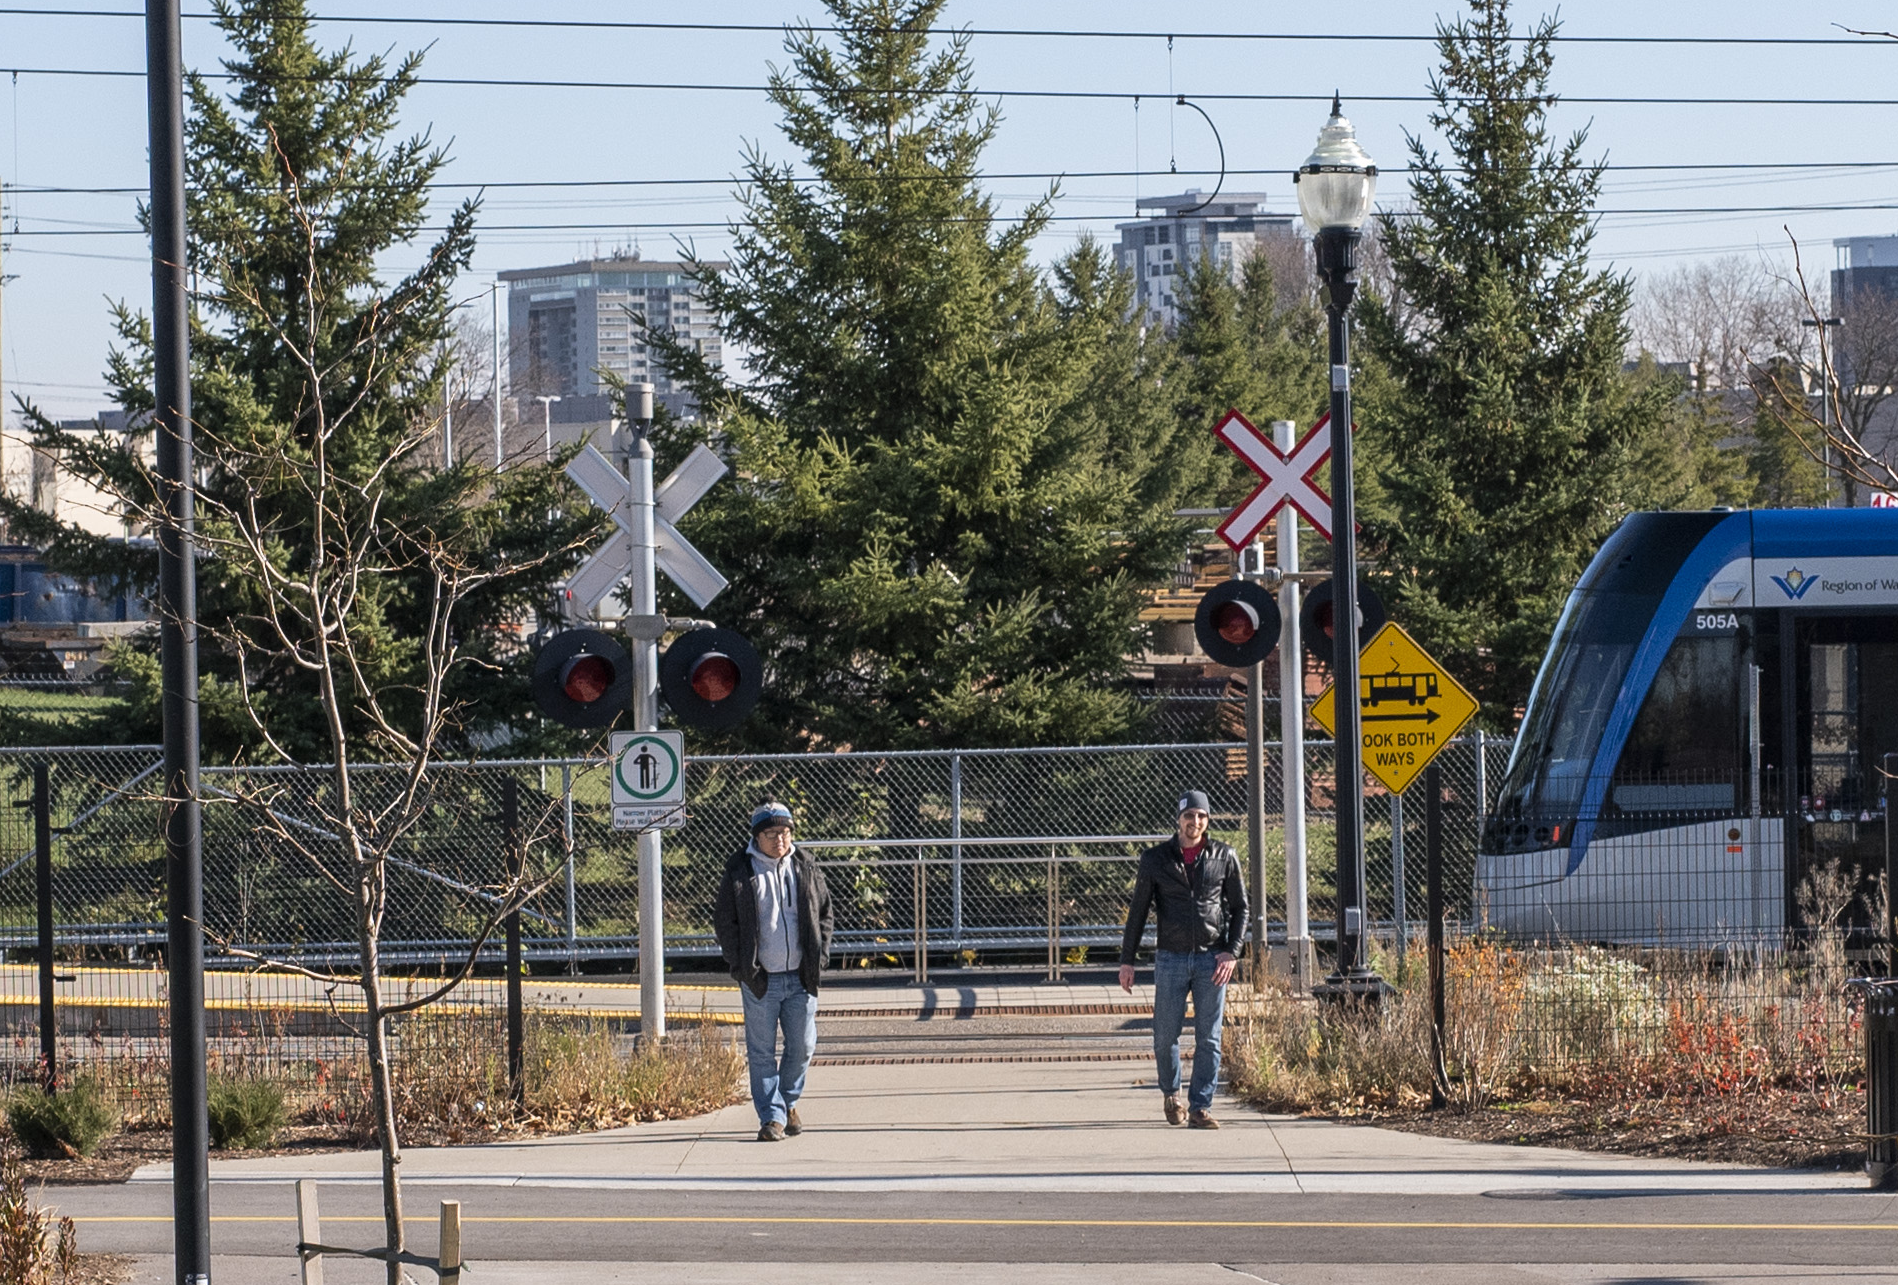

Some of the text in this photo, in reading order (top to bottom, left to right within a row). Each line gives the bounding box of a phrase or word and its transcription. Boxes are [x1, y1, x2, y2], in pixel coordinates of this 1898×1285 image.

[1821, 579, 1863, 594] Region
[1864, 578, 1878, 591] of
[1696, 614, 1739, 630] 505A
[1362, 732, 1435, 747] OOK BOTH
[1375, 752, 1415, 766] WAYS
